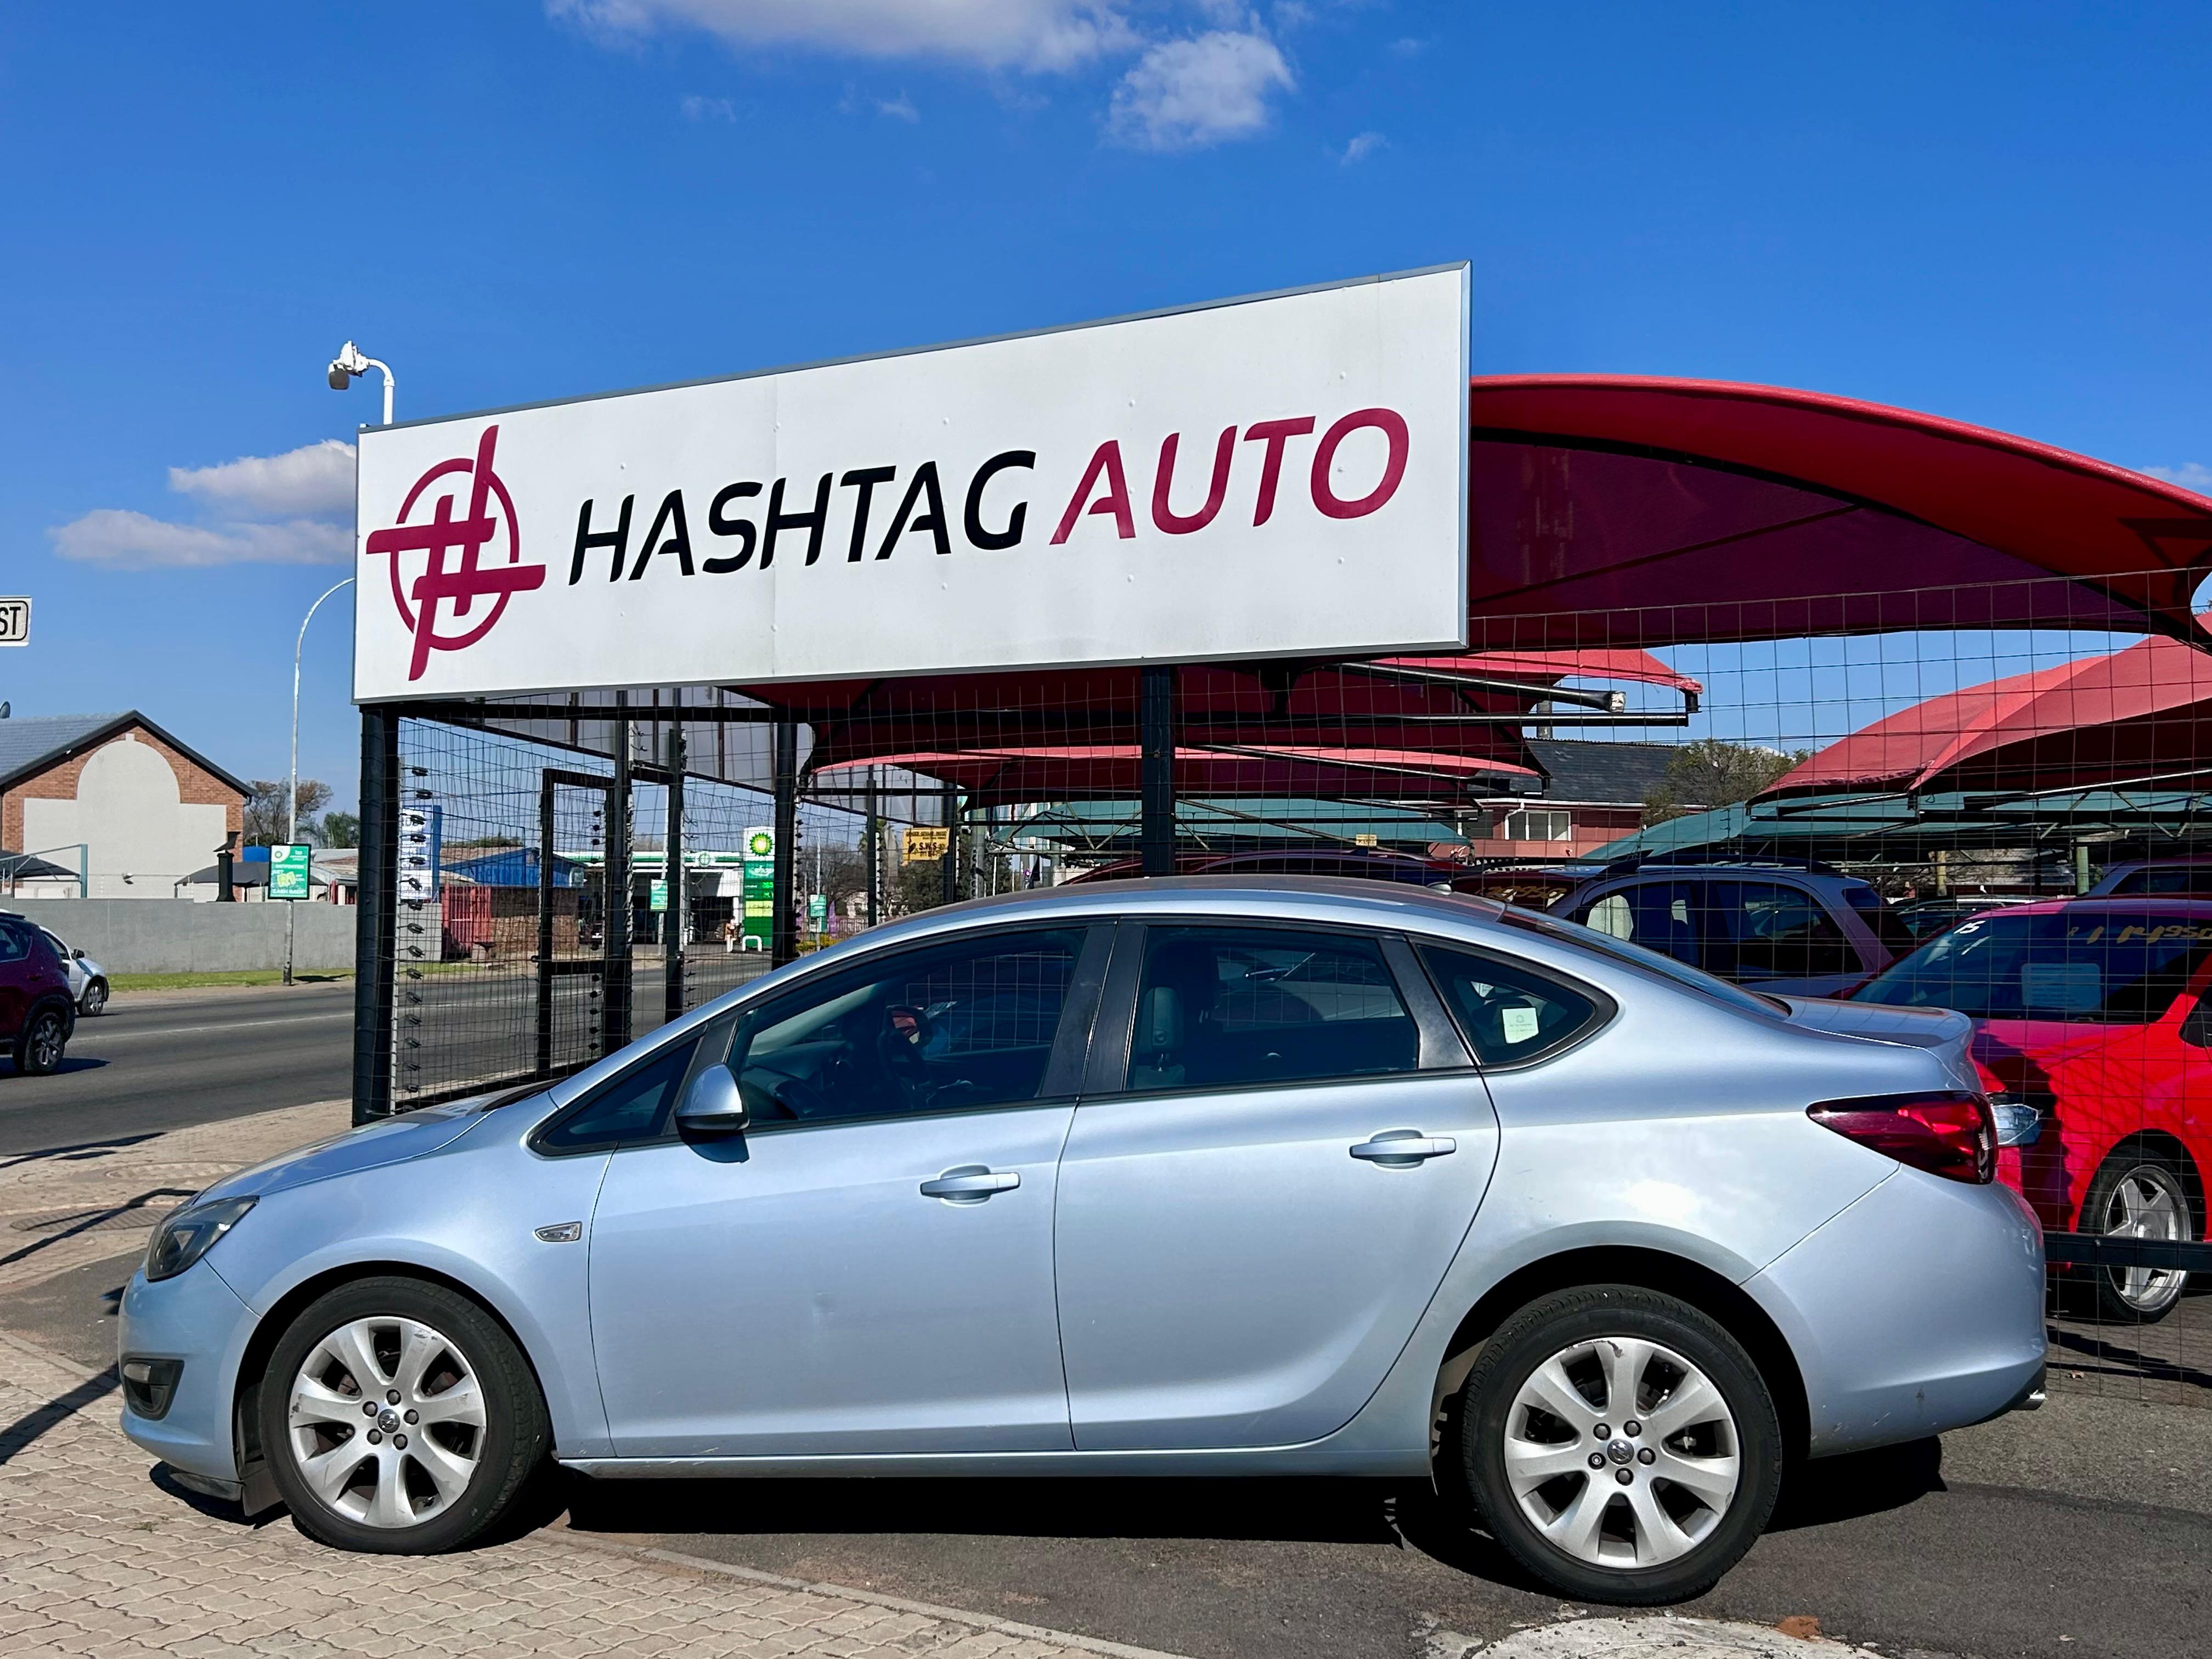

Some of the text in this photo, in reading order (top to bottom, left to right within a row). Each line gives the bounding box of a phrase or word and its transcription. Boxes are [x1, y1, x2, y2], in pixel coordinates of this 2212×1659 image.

[569, 408, 1409, 586] HASHTAG AUTO
[0, 606, 21, 635] ST
